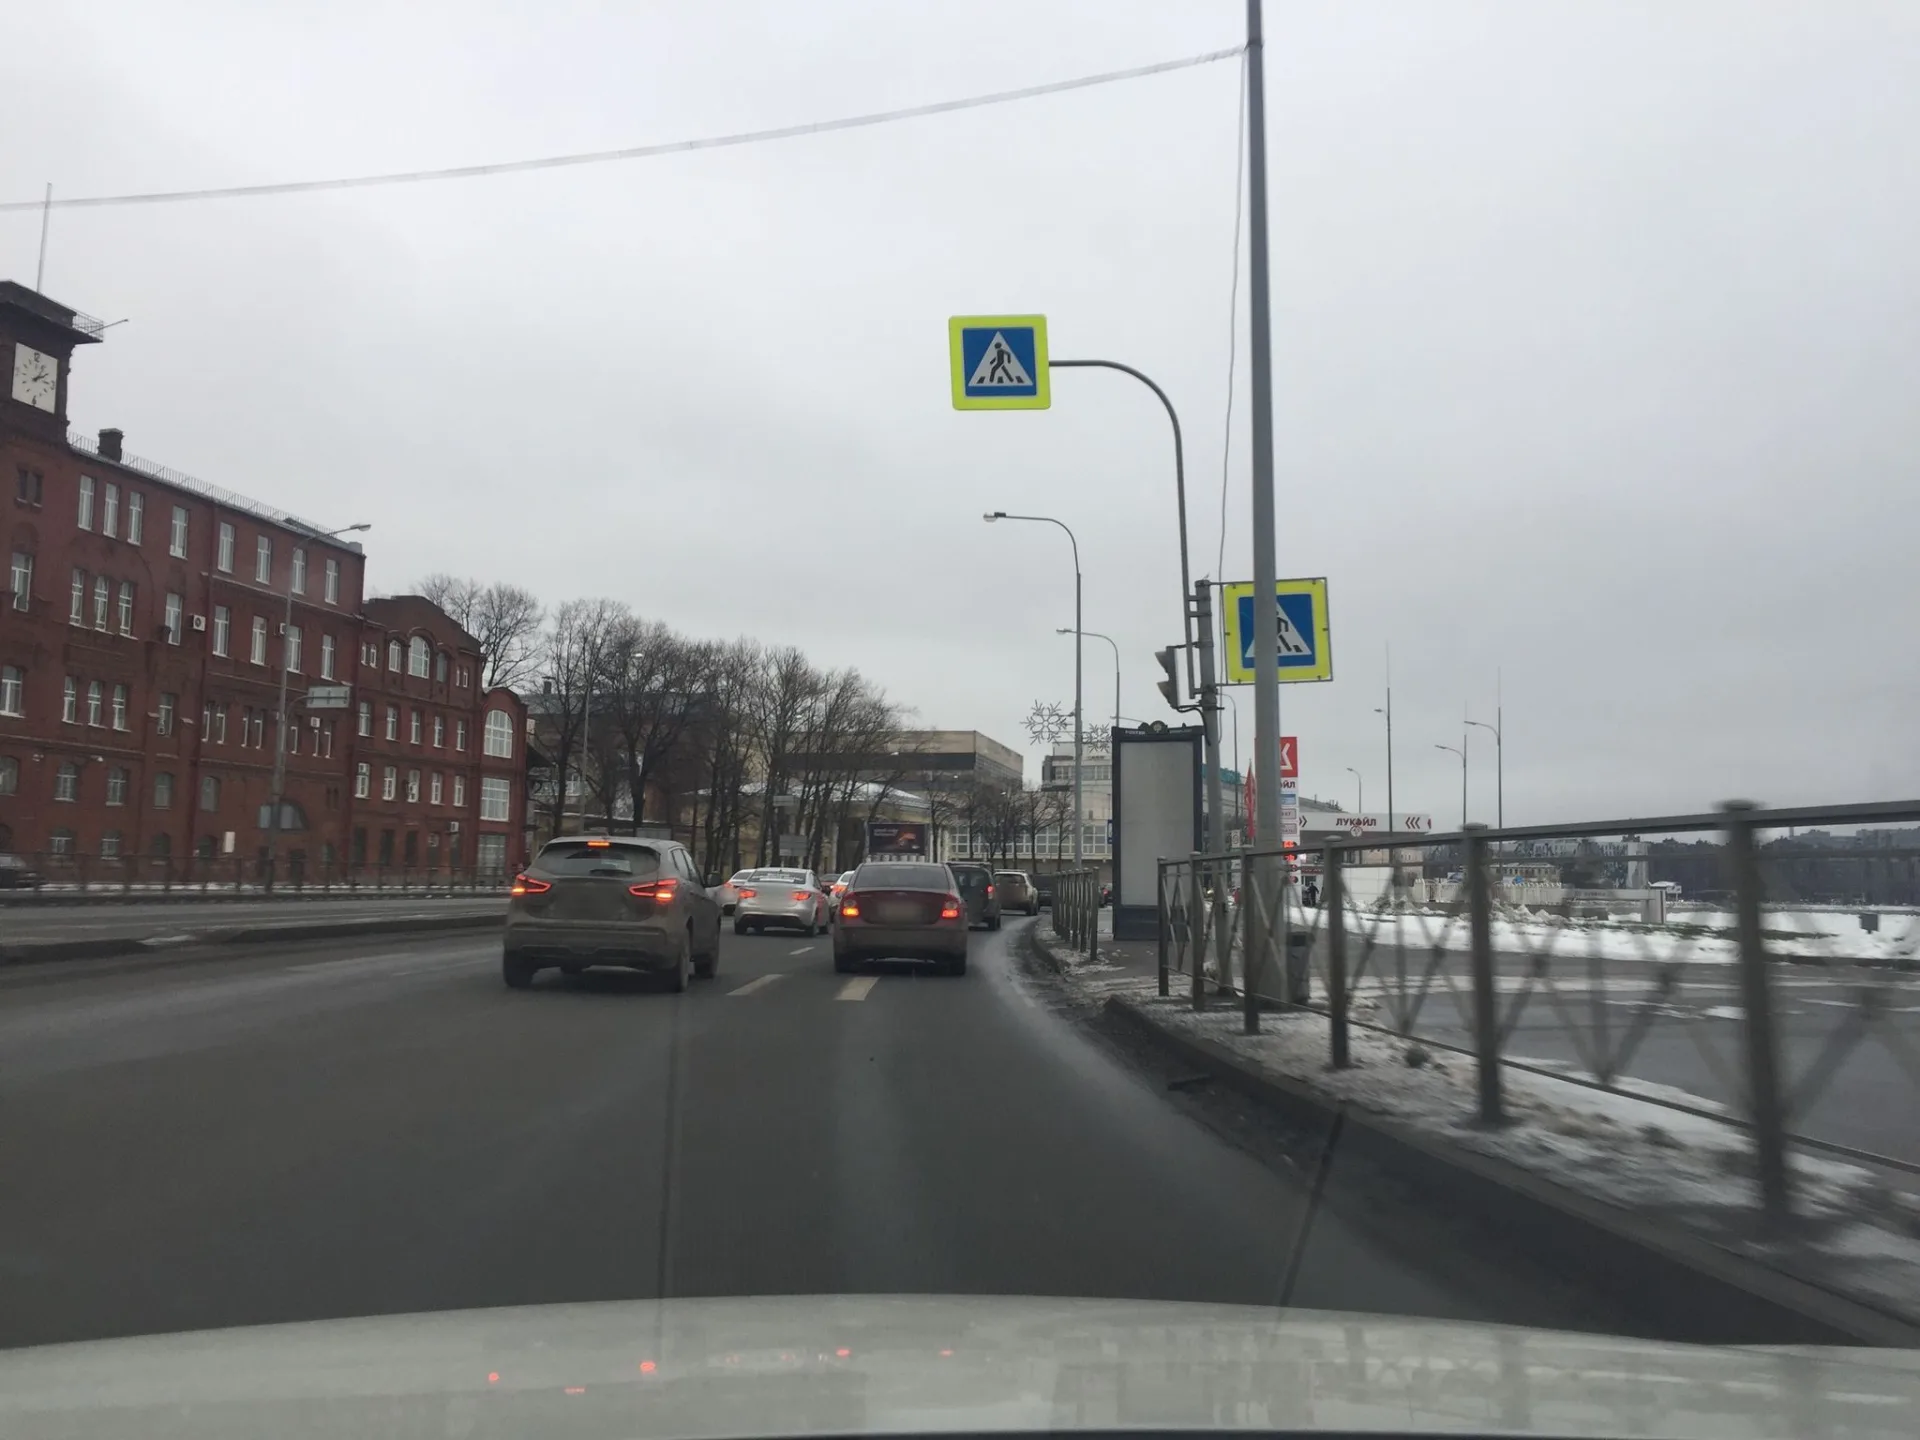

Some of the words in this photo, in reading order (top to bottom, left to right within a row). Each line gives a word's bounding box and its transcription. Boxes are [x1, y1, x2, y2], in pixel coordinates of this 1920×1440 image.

[33, 352, 41, 363] 12
[31, 395, 37, 405] 6
[1336, 817, 1377, 826] ЛУКОЙЛ
